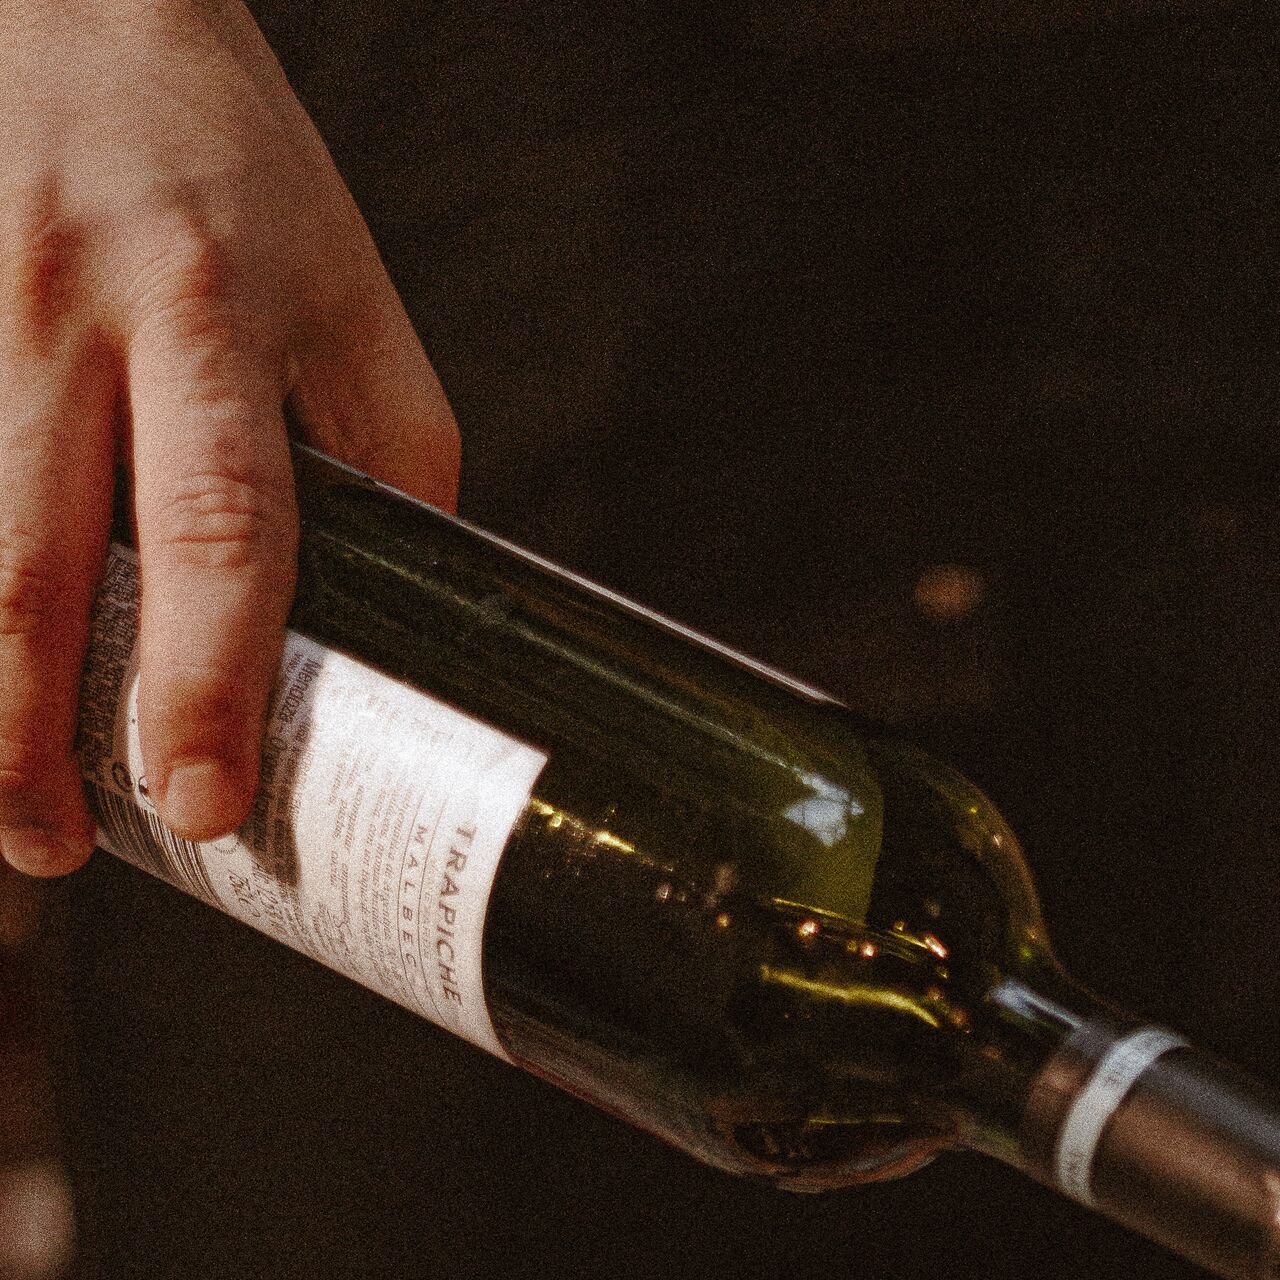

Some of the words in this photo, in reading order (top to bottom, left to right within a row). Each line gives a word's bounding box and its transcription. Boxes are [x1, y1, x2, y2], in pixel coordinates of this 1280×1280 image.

[277, 656, 322, 726] Mendoza
[400, 823, 429, 969] MALBEC
[436, 822, 477, 1005] TRAPICHE
